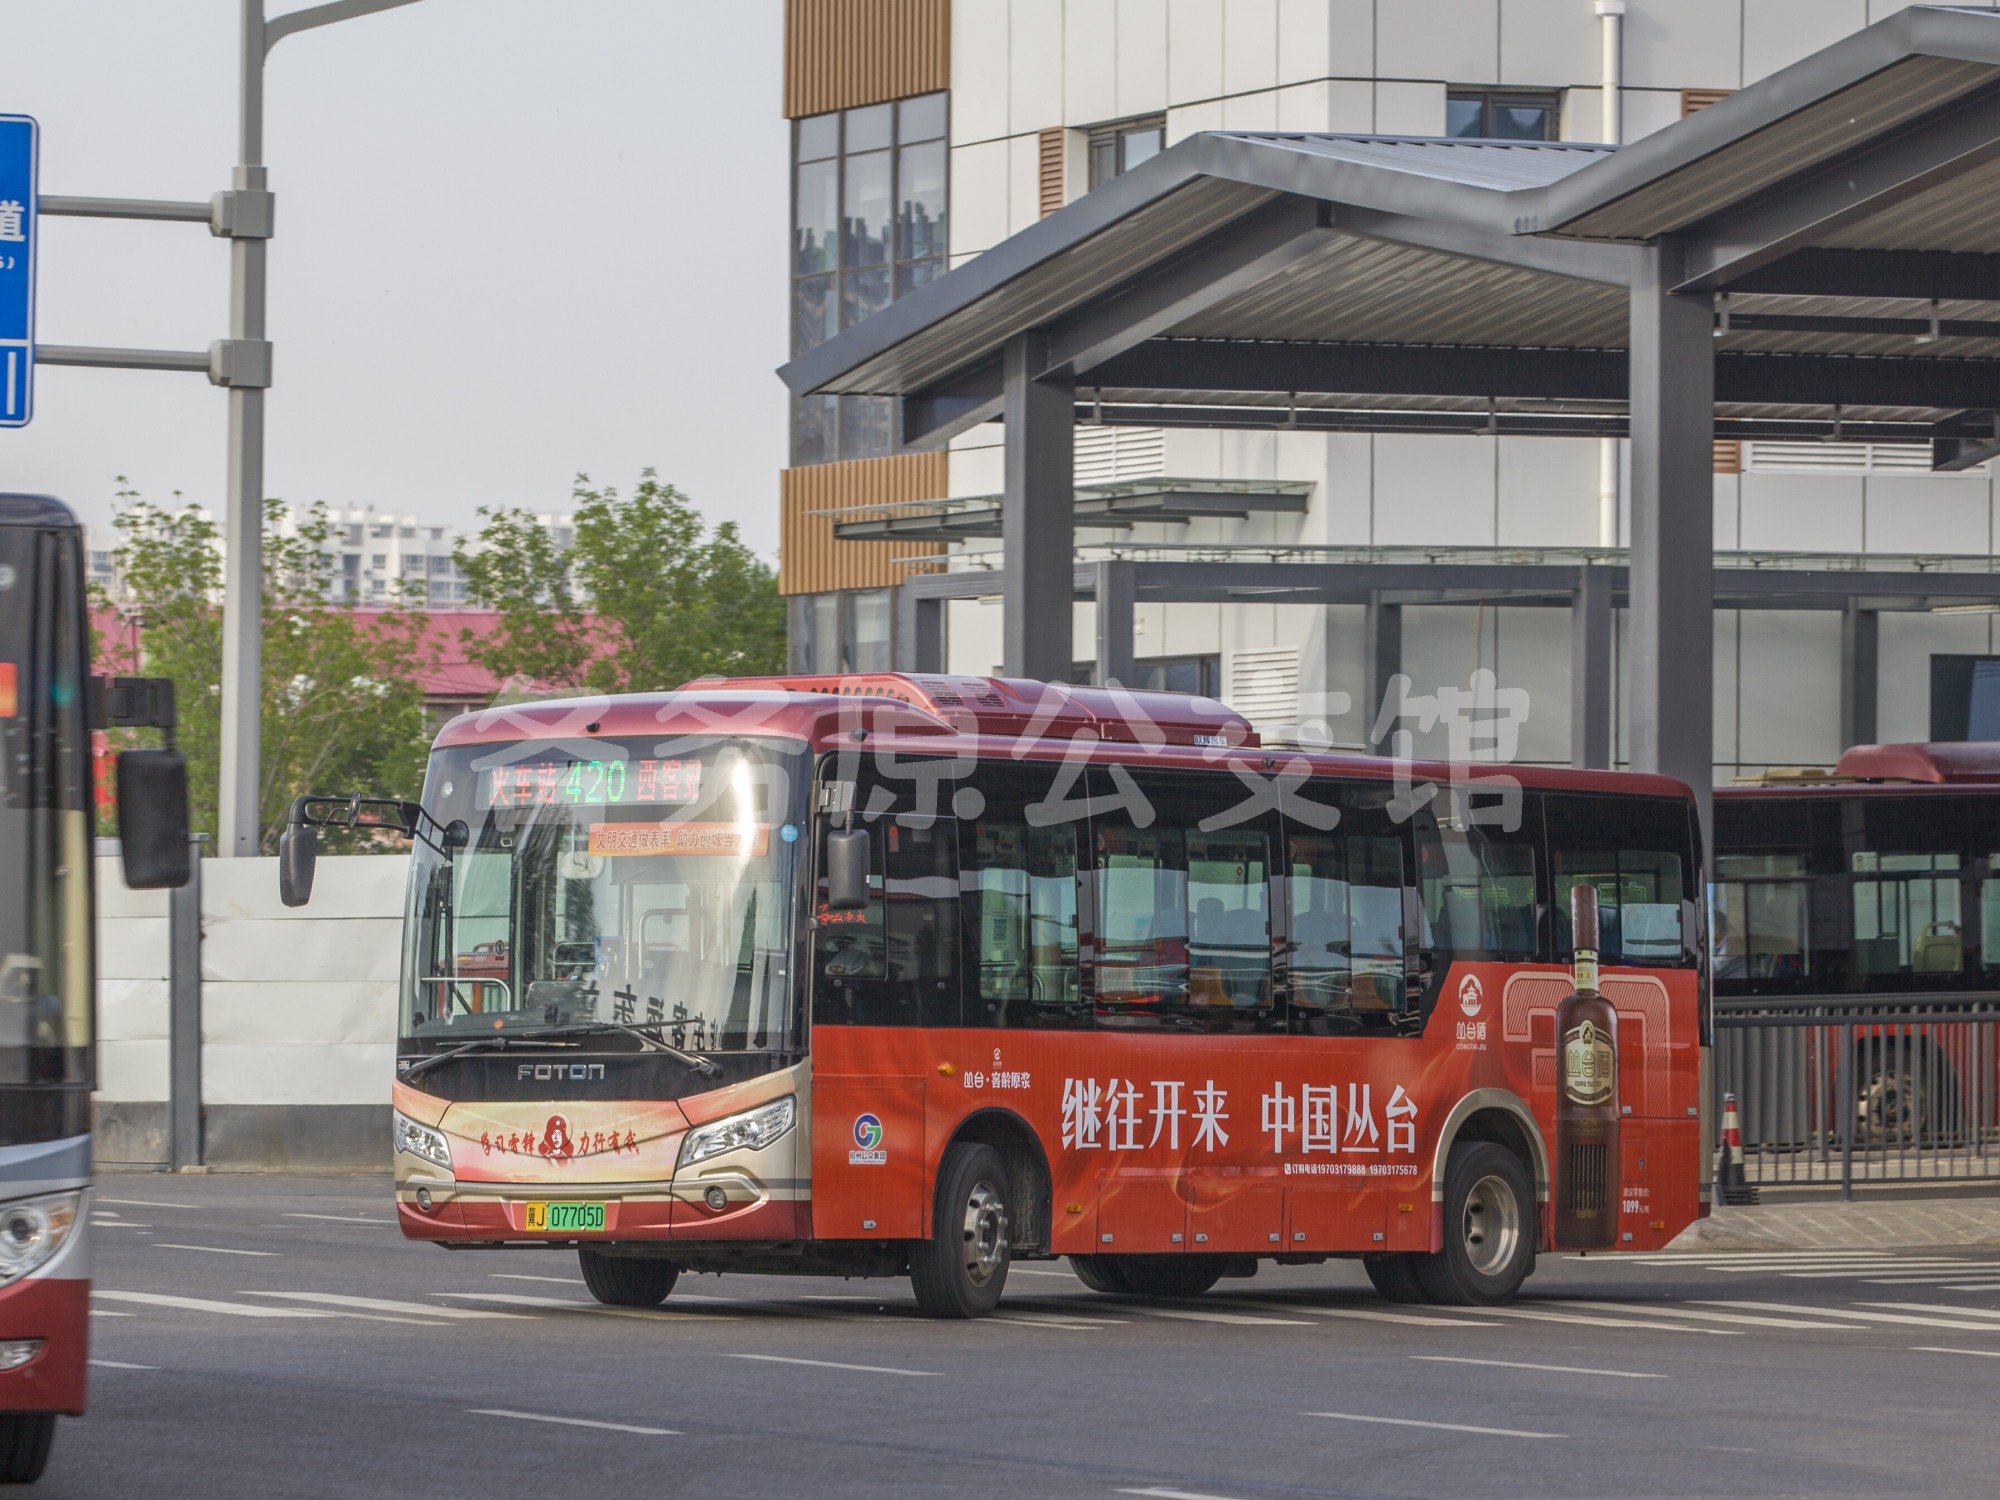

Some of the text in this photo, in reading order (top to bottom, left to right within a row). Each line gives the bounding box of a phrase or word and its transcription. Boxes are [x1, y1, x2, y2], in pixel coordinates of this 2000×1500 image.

[489, 759, 702, 806] 火车站 420 西客站
[596, 829, 671, 849] 文明交通做表率
[1456, 1021, 1487, 1040] 丛台酒
[517, 1064, 605, 1080] FOTON
[1061, 1078, 1418, 1154] 继往开来 中国丛台
[480, 1131, 536, 1156] 学习雷锋
[1370, 1164, 1418, 1176] 19703175678
